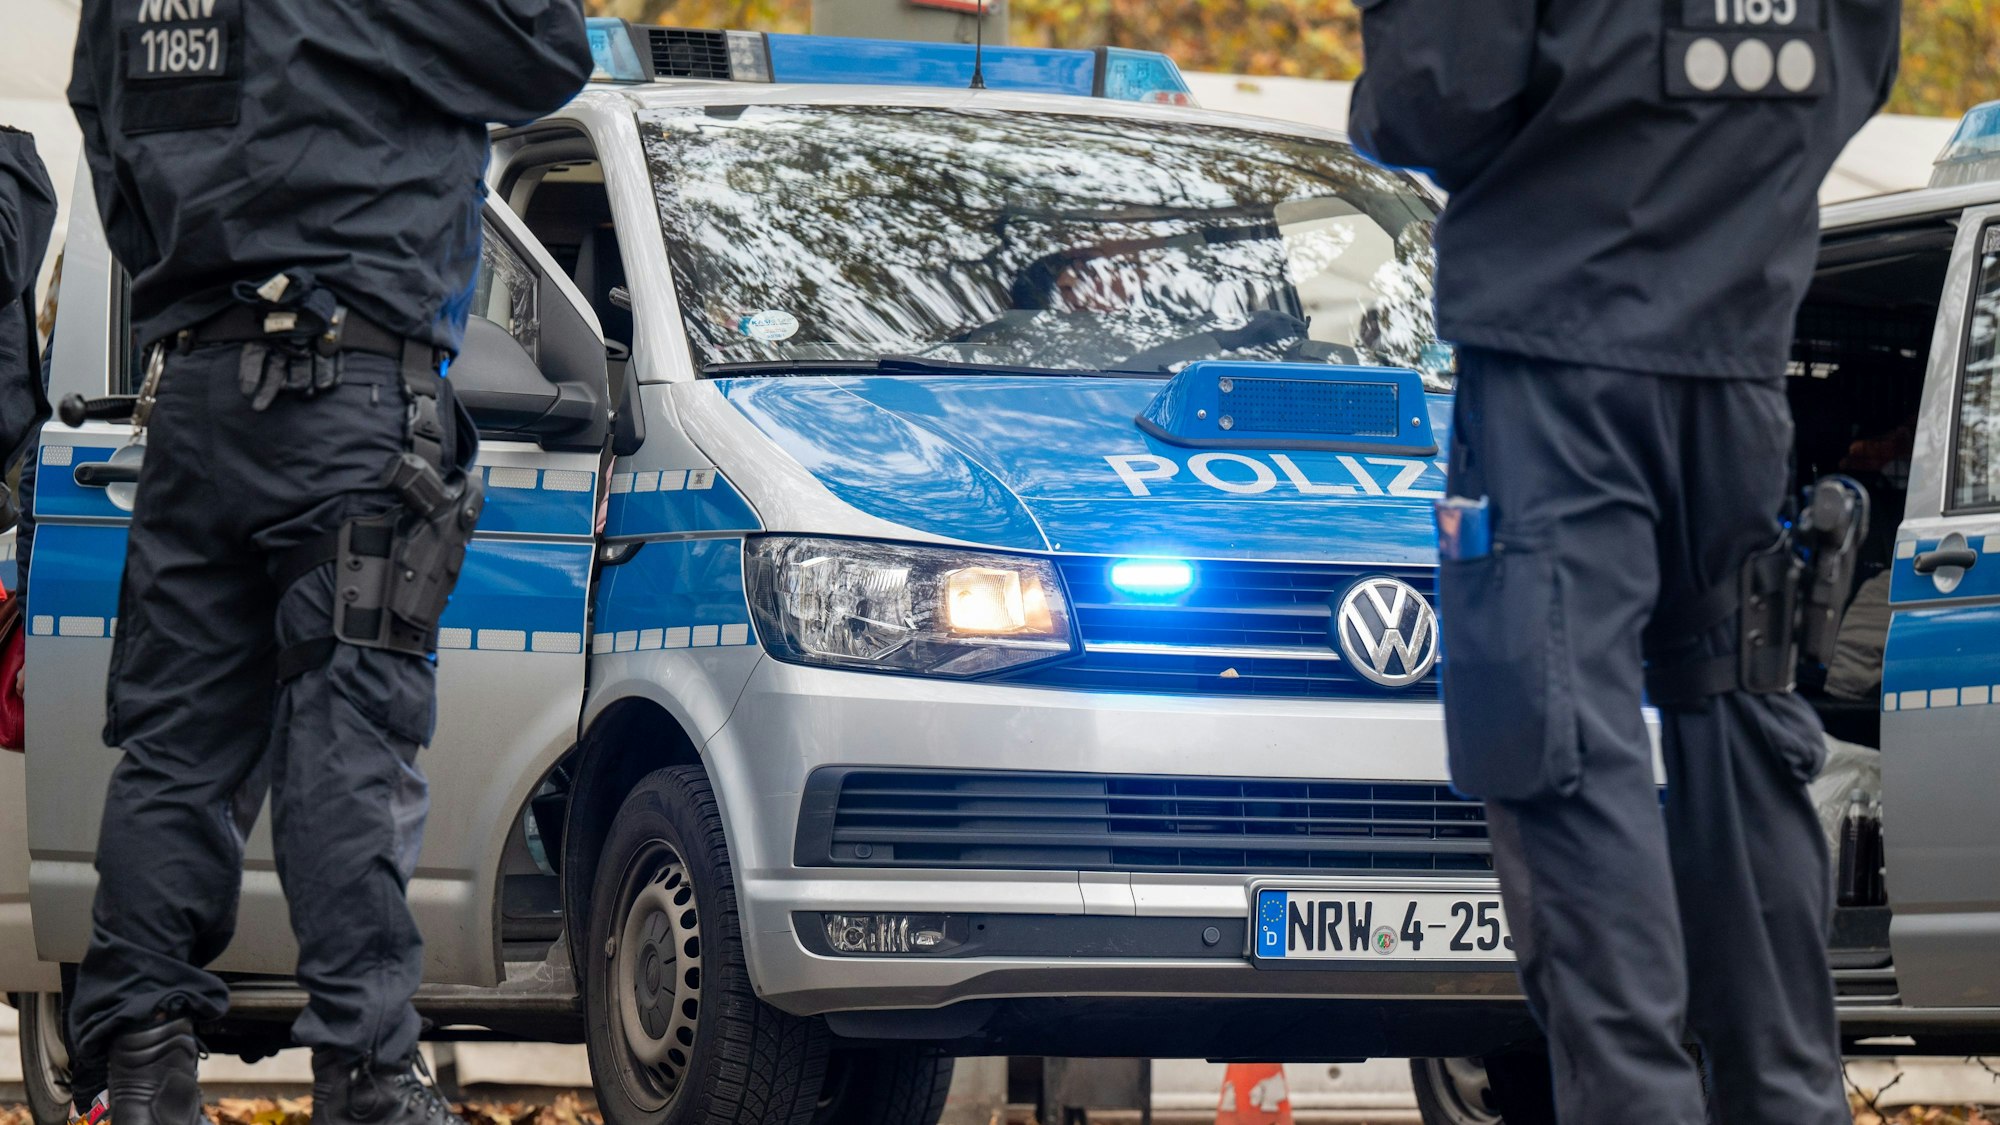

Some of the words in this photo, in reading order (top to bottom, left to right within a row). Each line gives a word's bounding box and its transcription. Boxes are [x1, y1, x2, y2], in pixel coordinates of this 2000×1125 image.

[141, 27, 219, 72] 11851
[1103, 453, 1447, 498] POLIZ
[1341, 581, 1436, 679] VW
[1266, 931, 1278, 946] D
[1288, 900, 1373, 951] NRW
[1400, 901, 1515, 951] 4-25
